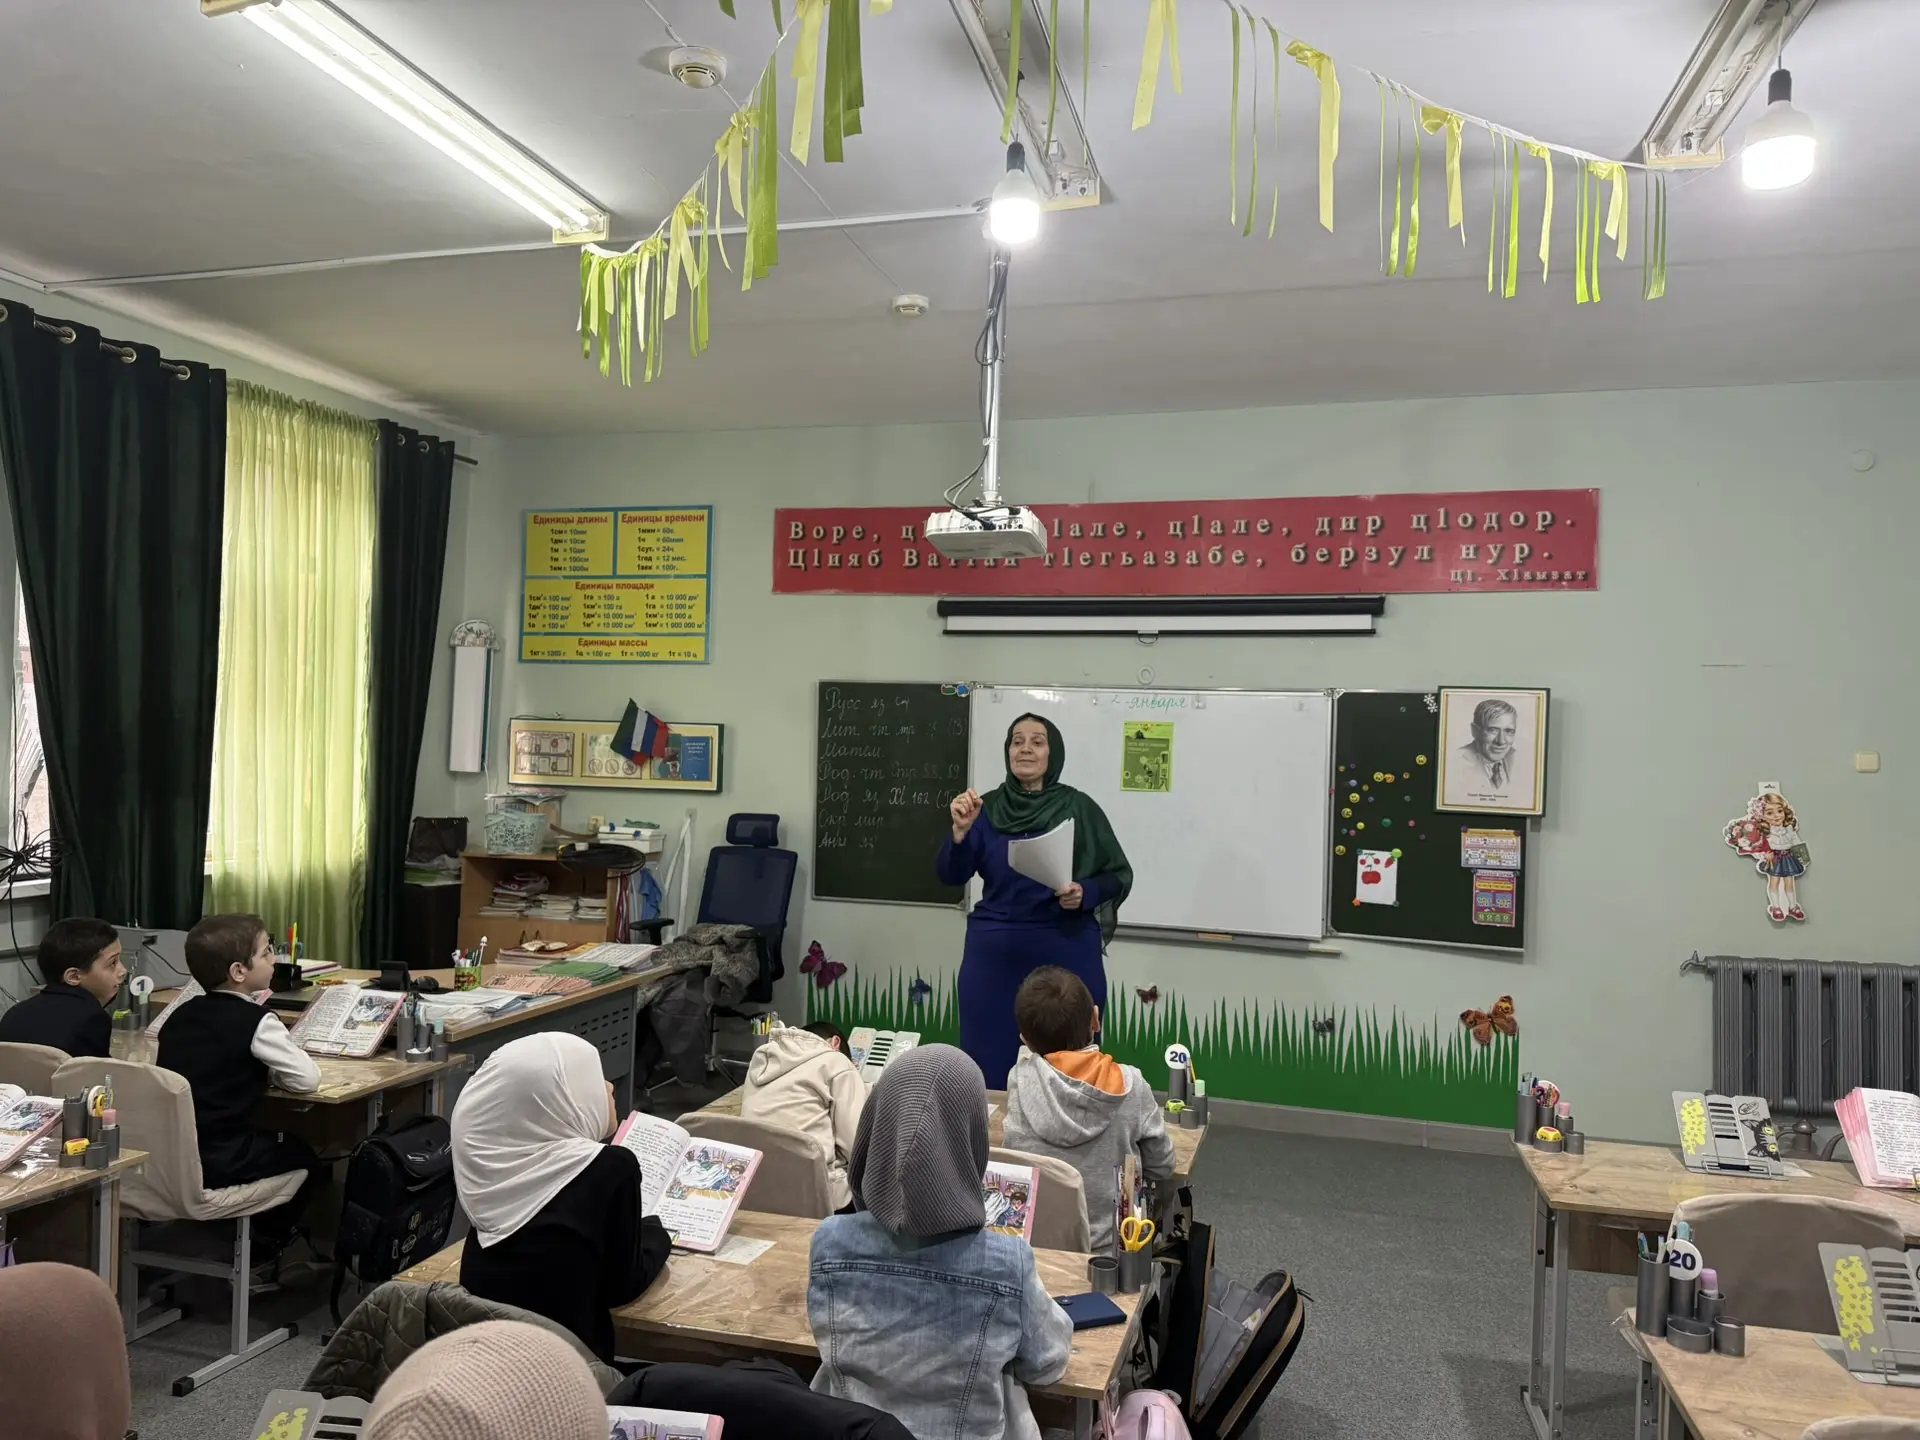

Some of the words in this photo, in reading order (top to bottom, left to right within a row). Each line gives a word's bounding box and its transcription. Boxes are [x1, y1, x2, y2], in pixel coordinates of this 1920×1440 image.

[533, 515, 574, 526] Единицы
[577, 516, 607, 525] длины
[622, 514, 662, 524] Единицы
[665, 514, 704, 524] времени
[1315, 515, 1381, 536] дир
[789, 521, 880, 543] Воре,
[1291, 543, 1431, 567] берзул
[1460, 543, 1550, 563] нур.
[575, 582, 613, 590] Единицы
[578, 638, 616, 647] Единицы
[136, 979, 145, 991] 1
[1169, 1051, 1186, 1063] 20
[1670, 1249, 1696, 1271] 20
